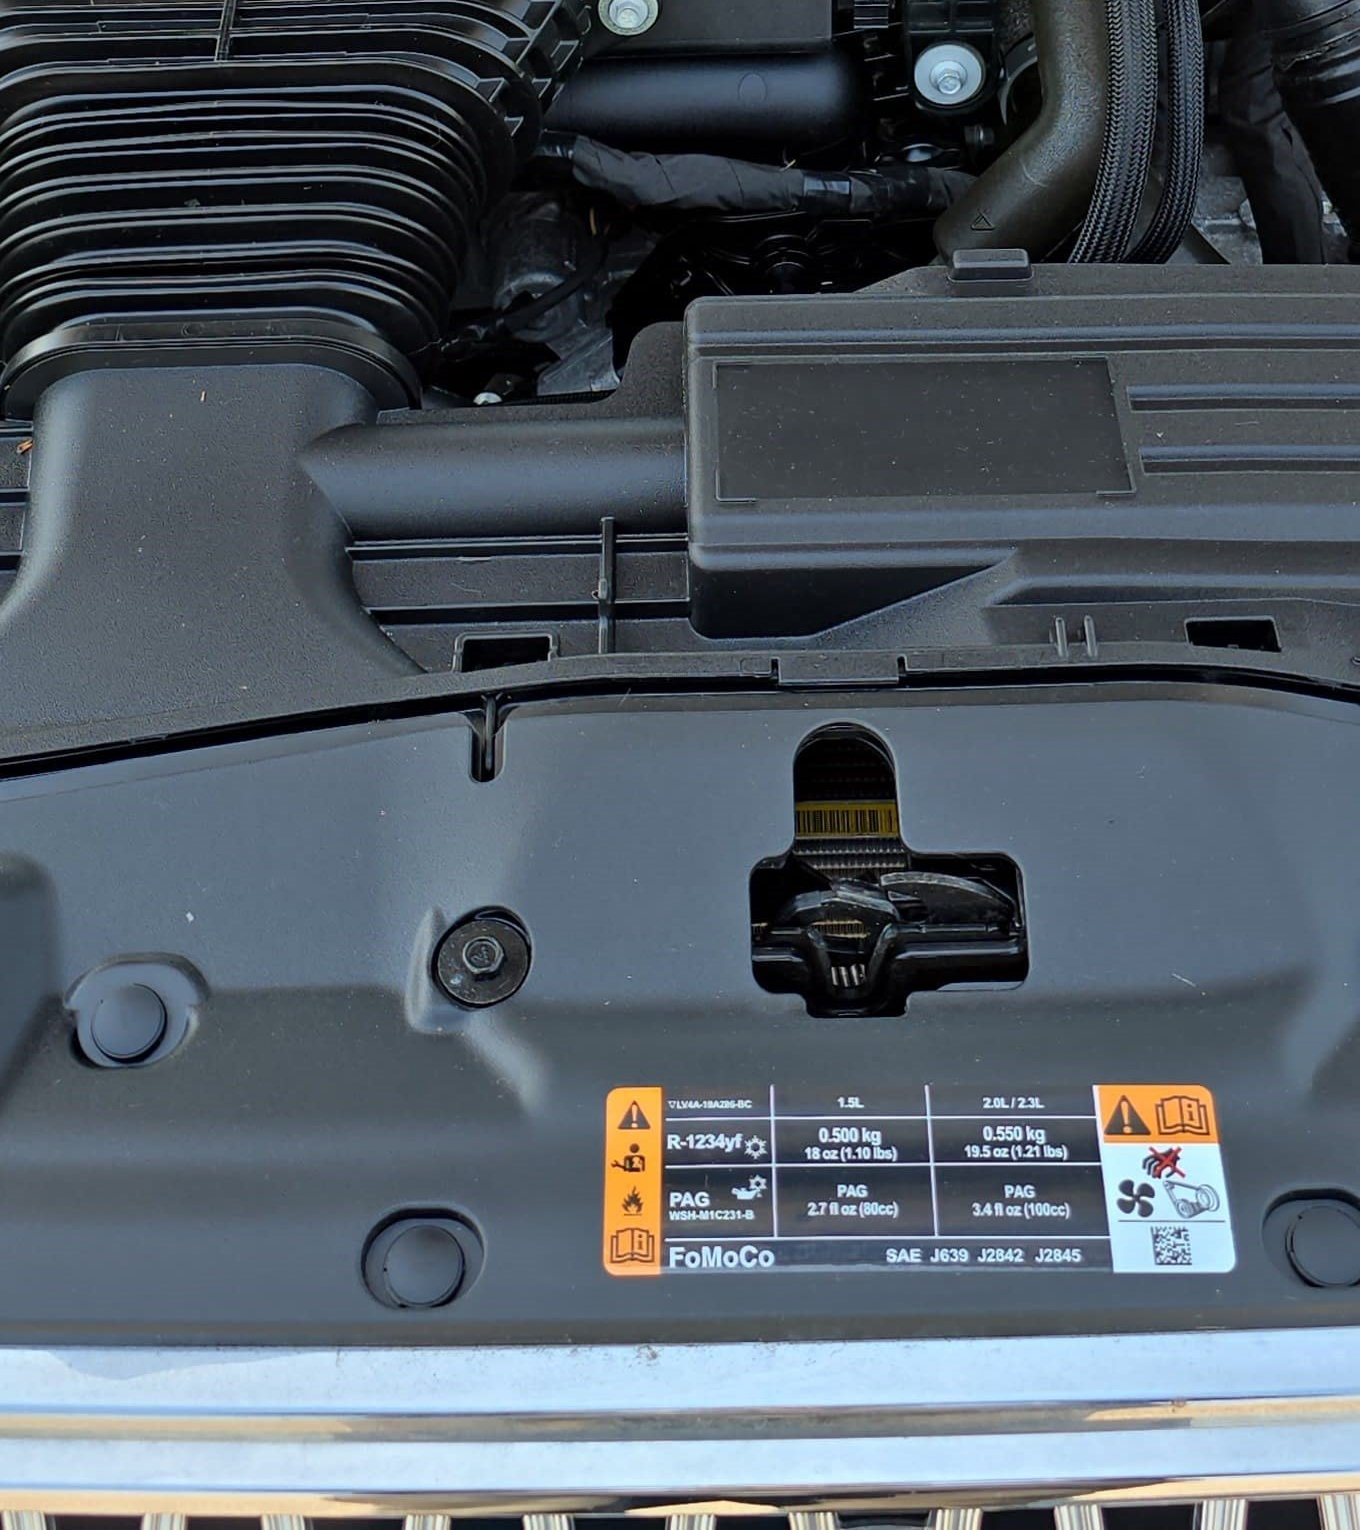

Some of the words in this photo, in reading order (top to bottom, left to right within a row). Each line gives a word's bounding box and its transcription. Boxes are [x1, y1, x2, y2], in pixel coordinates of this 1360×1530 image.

[837, 1097, 864, 1109] 1.5L
[982, 1097, 1010, 1109] 2.0L
[1017, 1097, 1045, 1109] 2.3L
[819, 1127, 859, 1143] 0.500
[861, 1127, 882, 1145] kg
[983, 1126, 1023, 1141] 0.550
[1026, 1126, 1045, 1144] kg
[667, 1134, 743, 1152] R-1234yf
[805, 1147, 821, 1159] 18
[823, 1149, 839, 1160] oz
[840, 1147, 872, 1162] (1.10
[873, 1147, 897, 1162] lbs)
[964, 1145, 991, 1158] 19.5
[993, 1147, 1010, 1158] oz
[1011, 1145, 1040, 1160] (1.21
[1043, 1145, 1068, 1160] lbs)
[837, 1185, 868, 1197] PAG
[1004, 1185, 1036, 1198] PAG
[669, 1192, 710, 1207] PAG
[669, 1210, 755, 1220] WSH-M1C231-B
[807, 1203, 828, 1216] 2.7
[829, 1202, 839, 1215] fl
[841, 1204, 857, 1216] oz
[859, 1202, 899, 1218] (80cc)
[972, 1203, 992, 1216] 3.4
[994, 1203, 1004, 1216] fl
[1006, 1205, 1022, 1216] oz
[1024, 1203, 1070, 1219] (100cc)
[669, 1245, 775, 1268] FoMoCo
[886, 1249, 922, 1262] SAE
[930, 1248, 969, 1263] J639
[977, 1249, 1024, 1262] J2842
[1035, 1249, 1082, 1262] J2845
